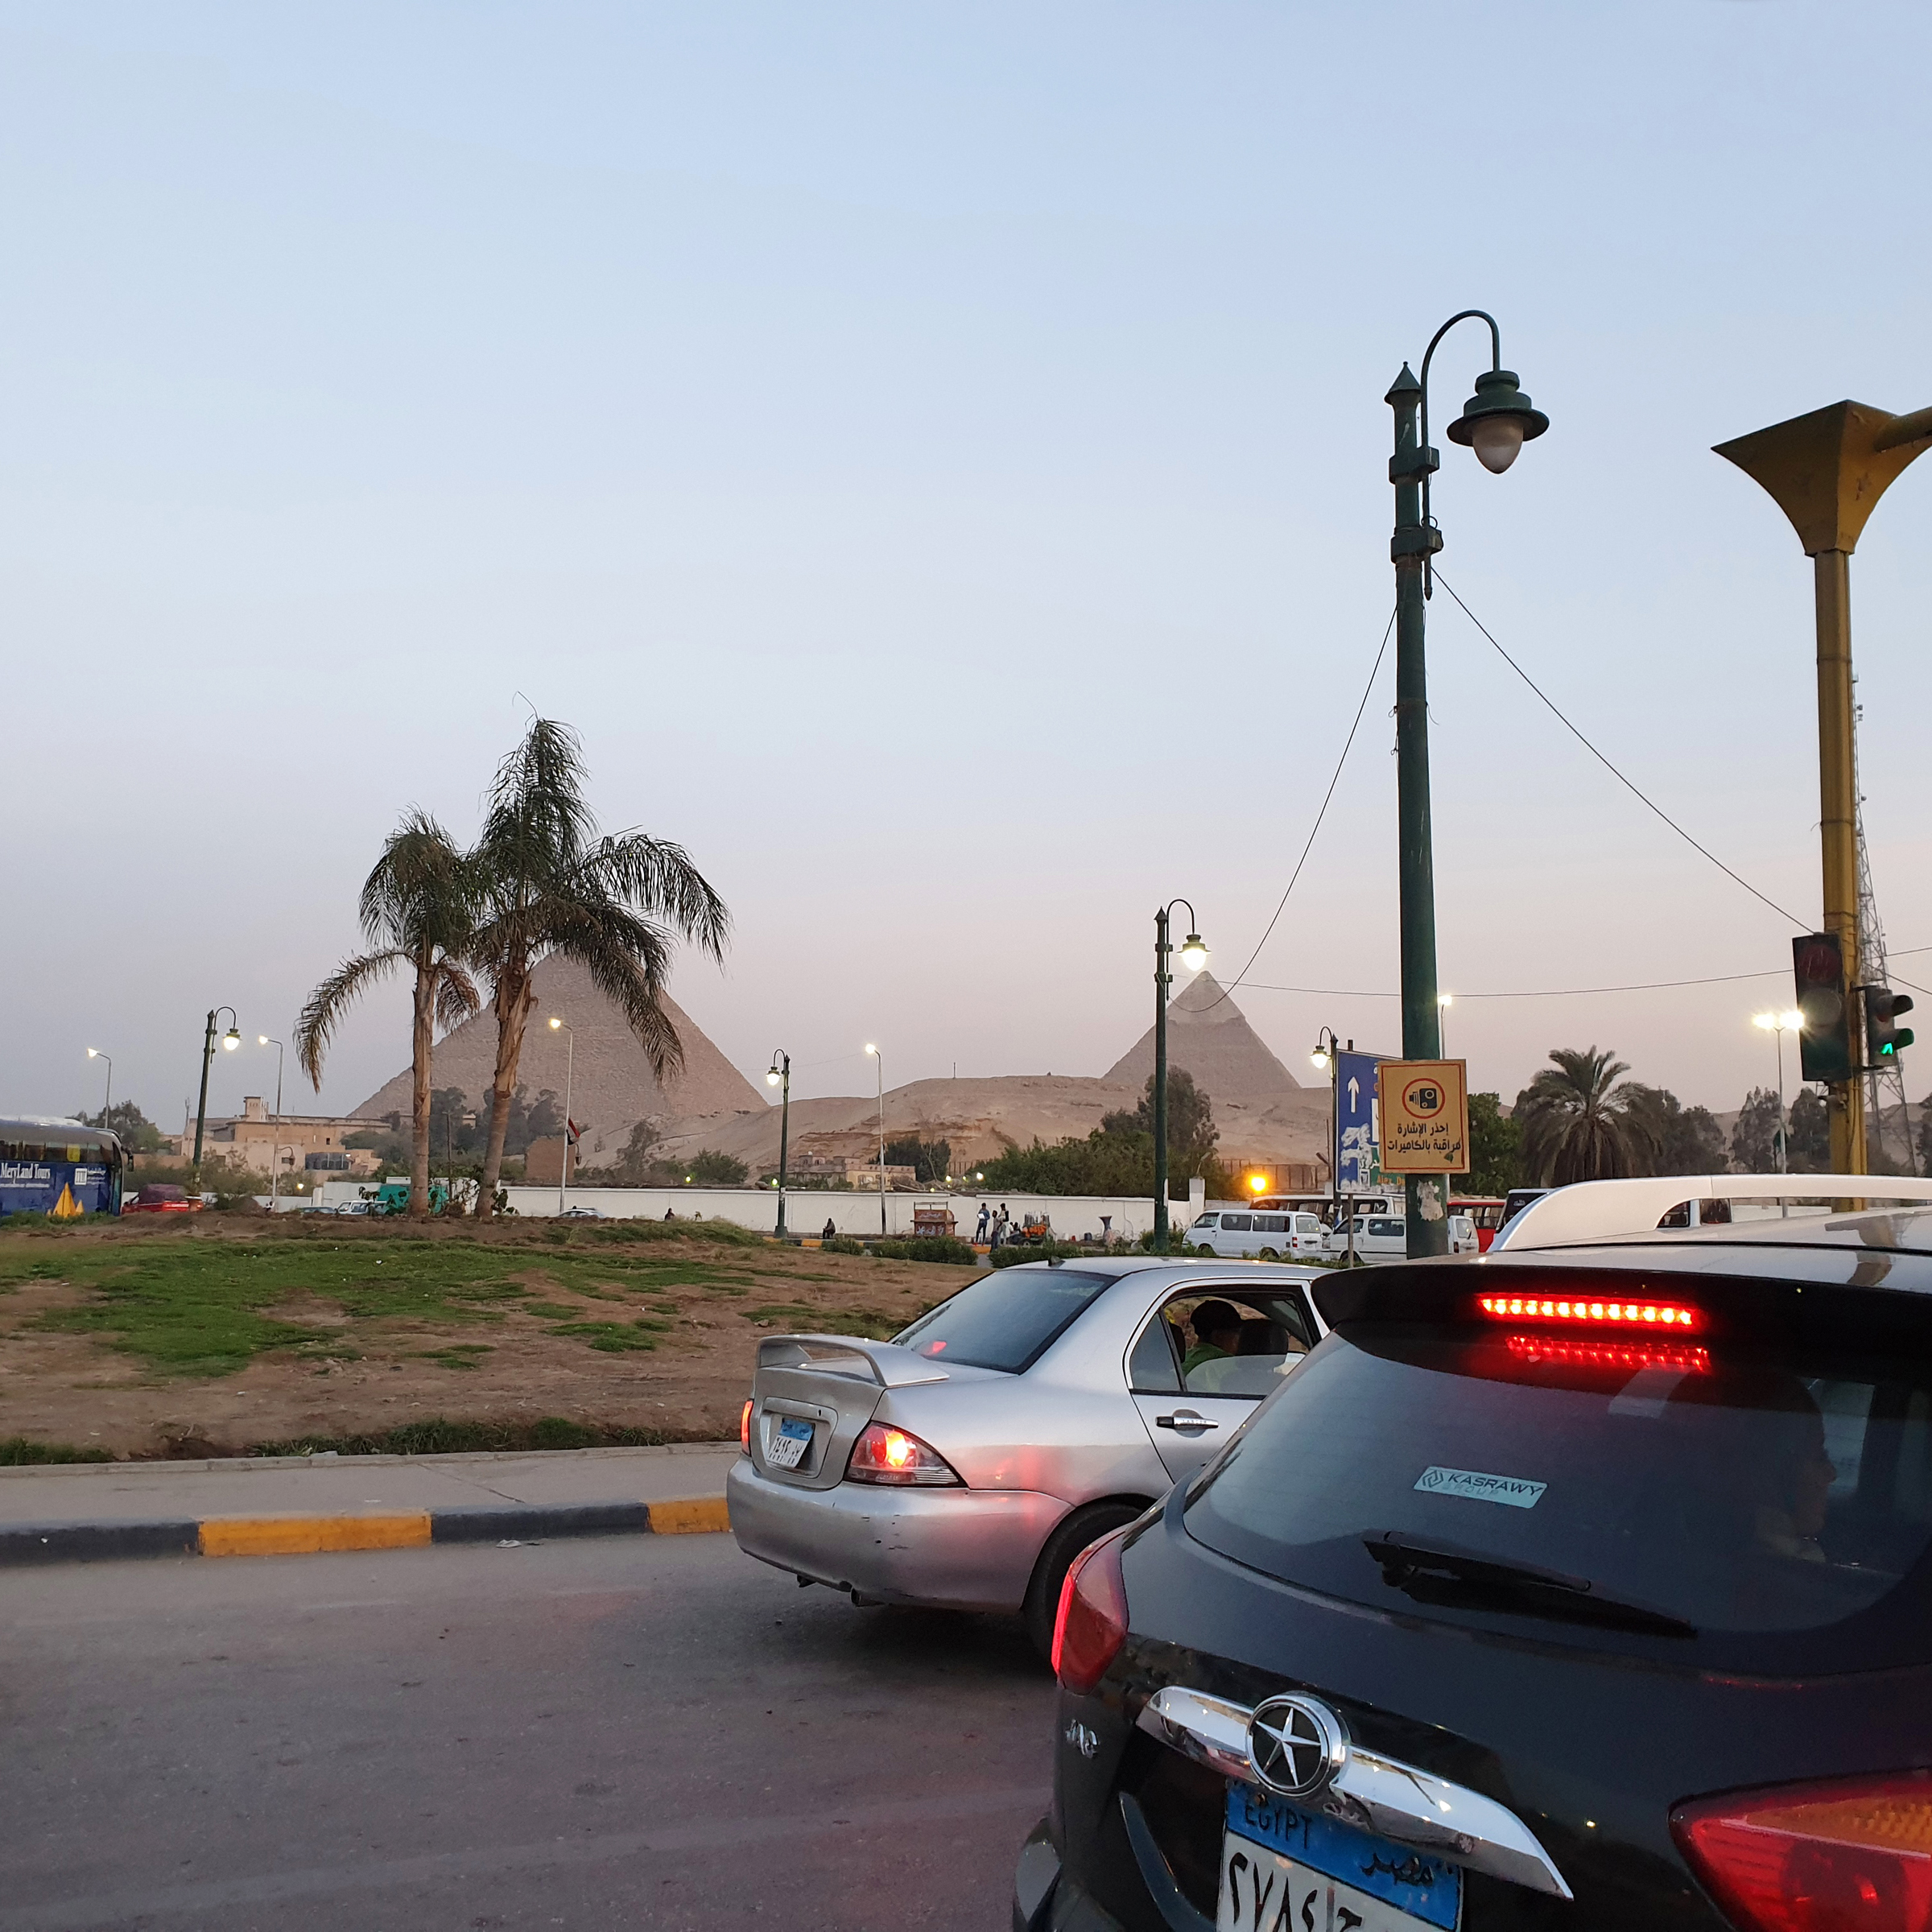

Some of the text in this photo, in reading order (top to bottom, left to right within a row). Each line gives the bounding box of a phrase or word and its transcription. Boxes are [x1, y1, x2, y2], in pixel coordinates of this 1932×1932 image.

[1397, 1121, 1426, 1137] الإشارة
[1387, 1137, 1461, 1154] مراقبة بالكاميرات
[34, 1163, 51, 1179] Tours
[1448, 1473, 1544, 1496] KASRAWY
[1245, 1804, 1312, 1850] EGYPT
[1361, 1853, 1435, 1887] مصر
